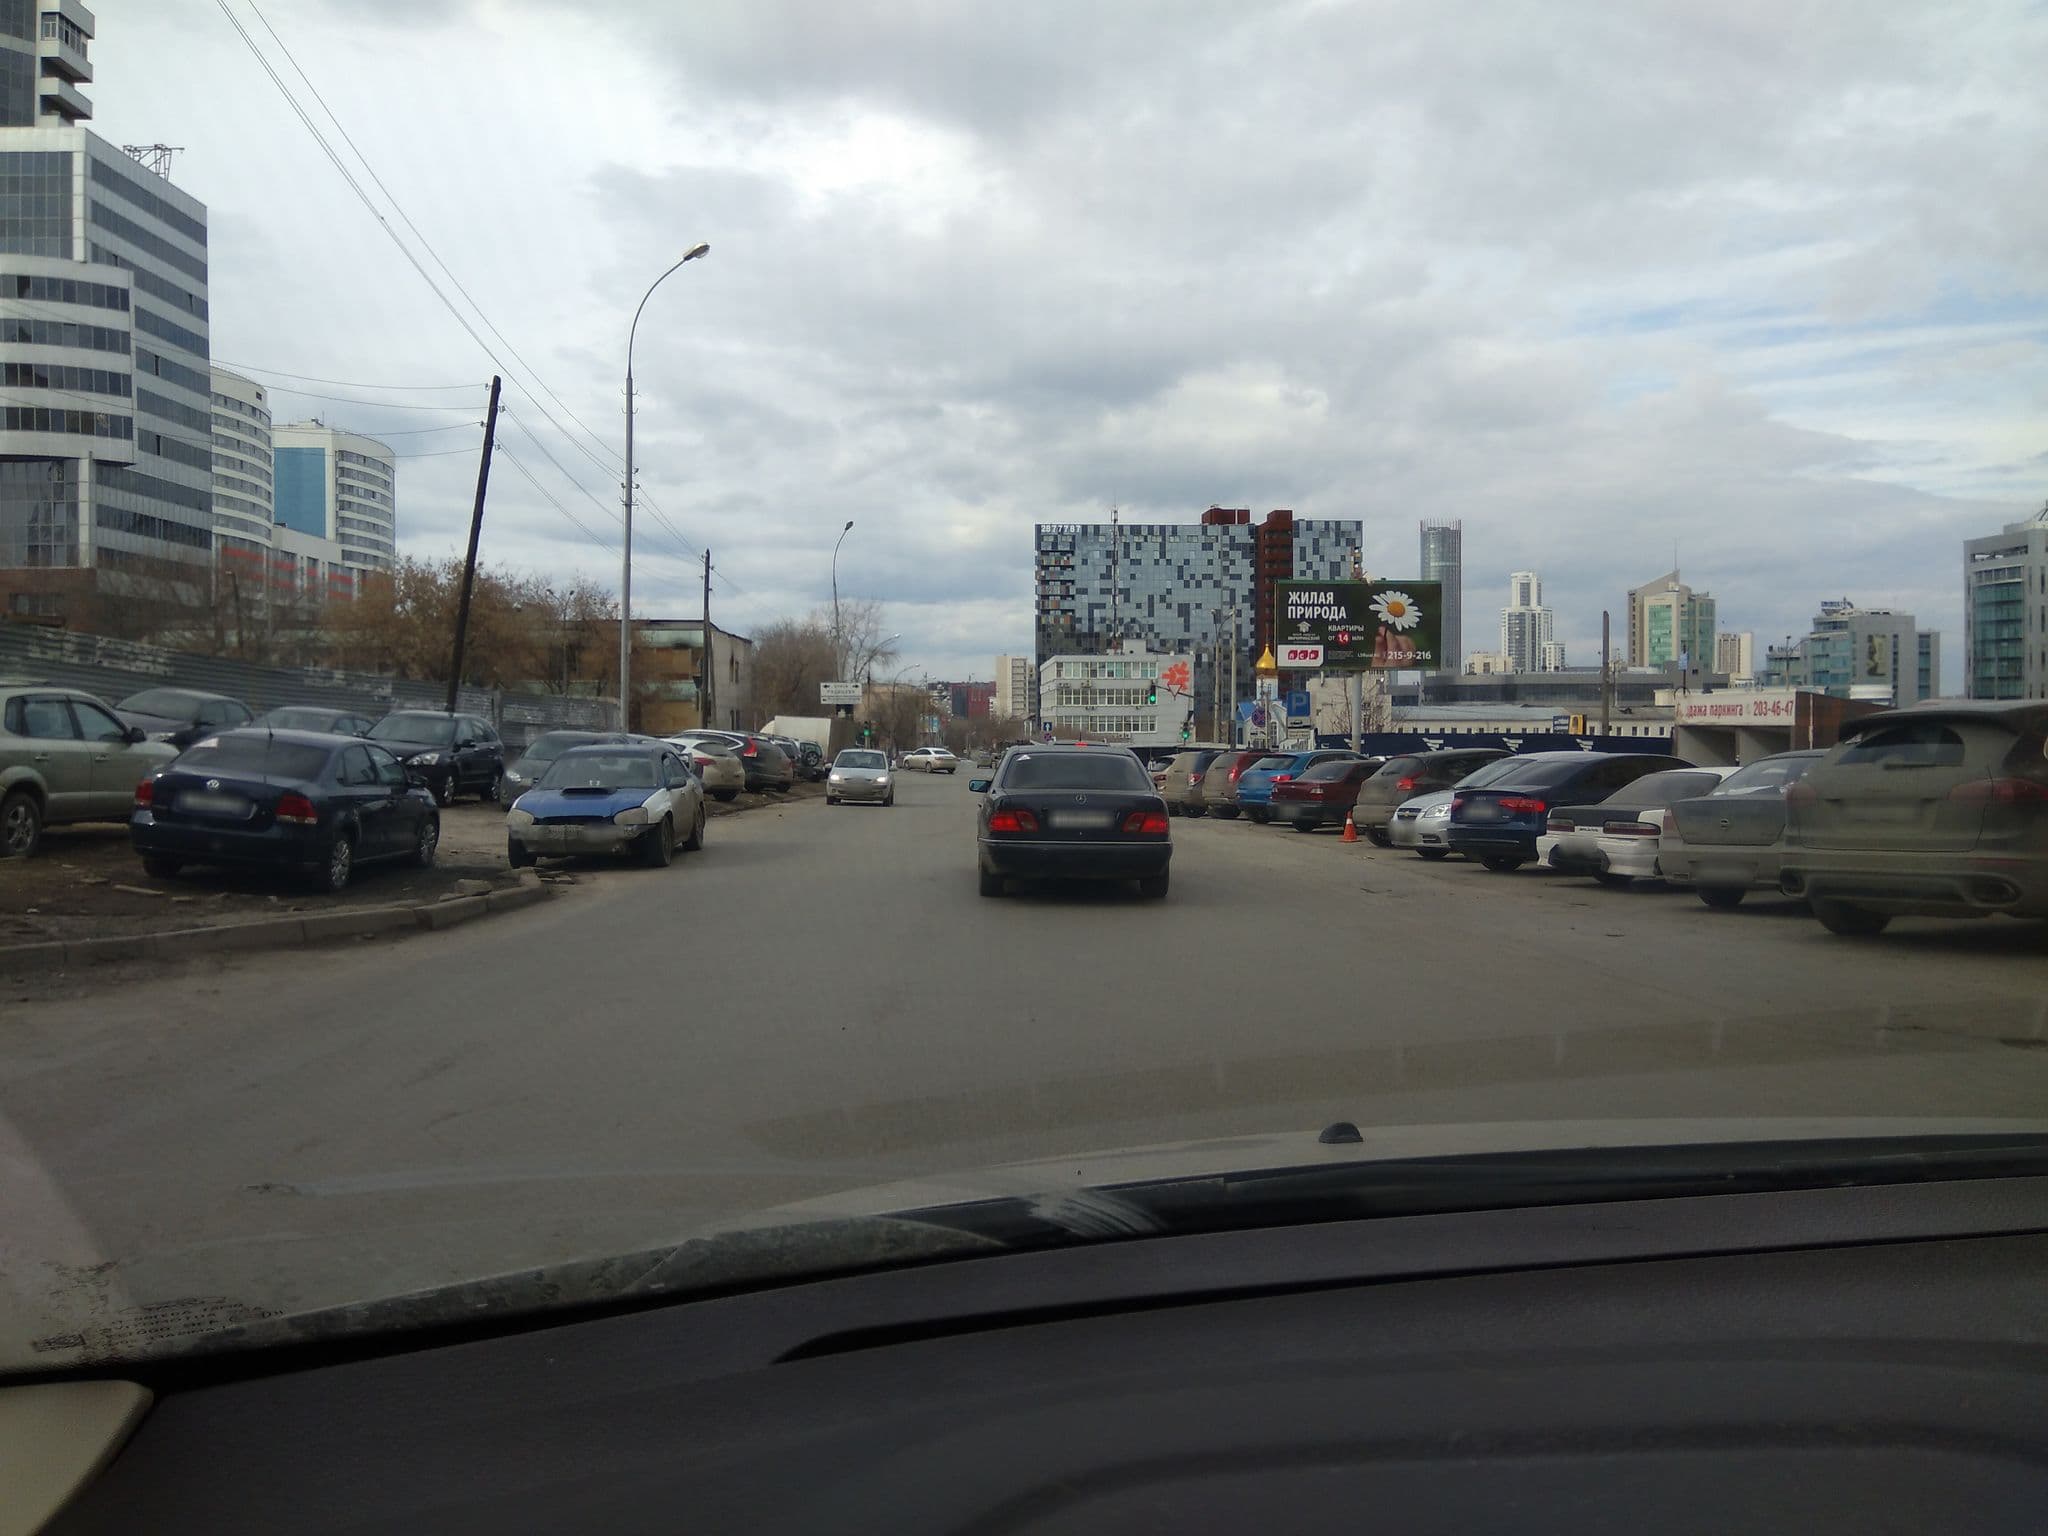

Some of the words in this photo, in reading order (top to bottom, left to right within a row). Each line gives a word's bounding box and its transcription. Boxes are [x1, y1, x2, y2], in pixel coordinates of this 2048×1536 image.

[1288, 592, 1334, 605] ЖИЛАЯ
[1288, 606, 1347, 621] ПРИРОДА
[1328, 624, 1365, 632] КВАРТИРЫ
[1387, 651, 1432, 660] 215-9-216
[1753, 700, 1794, 717] 203-46-47
